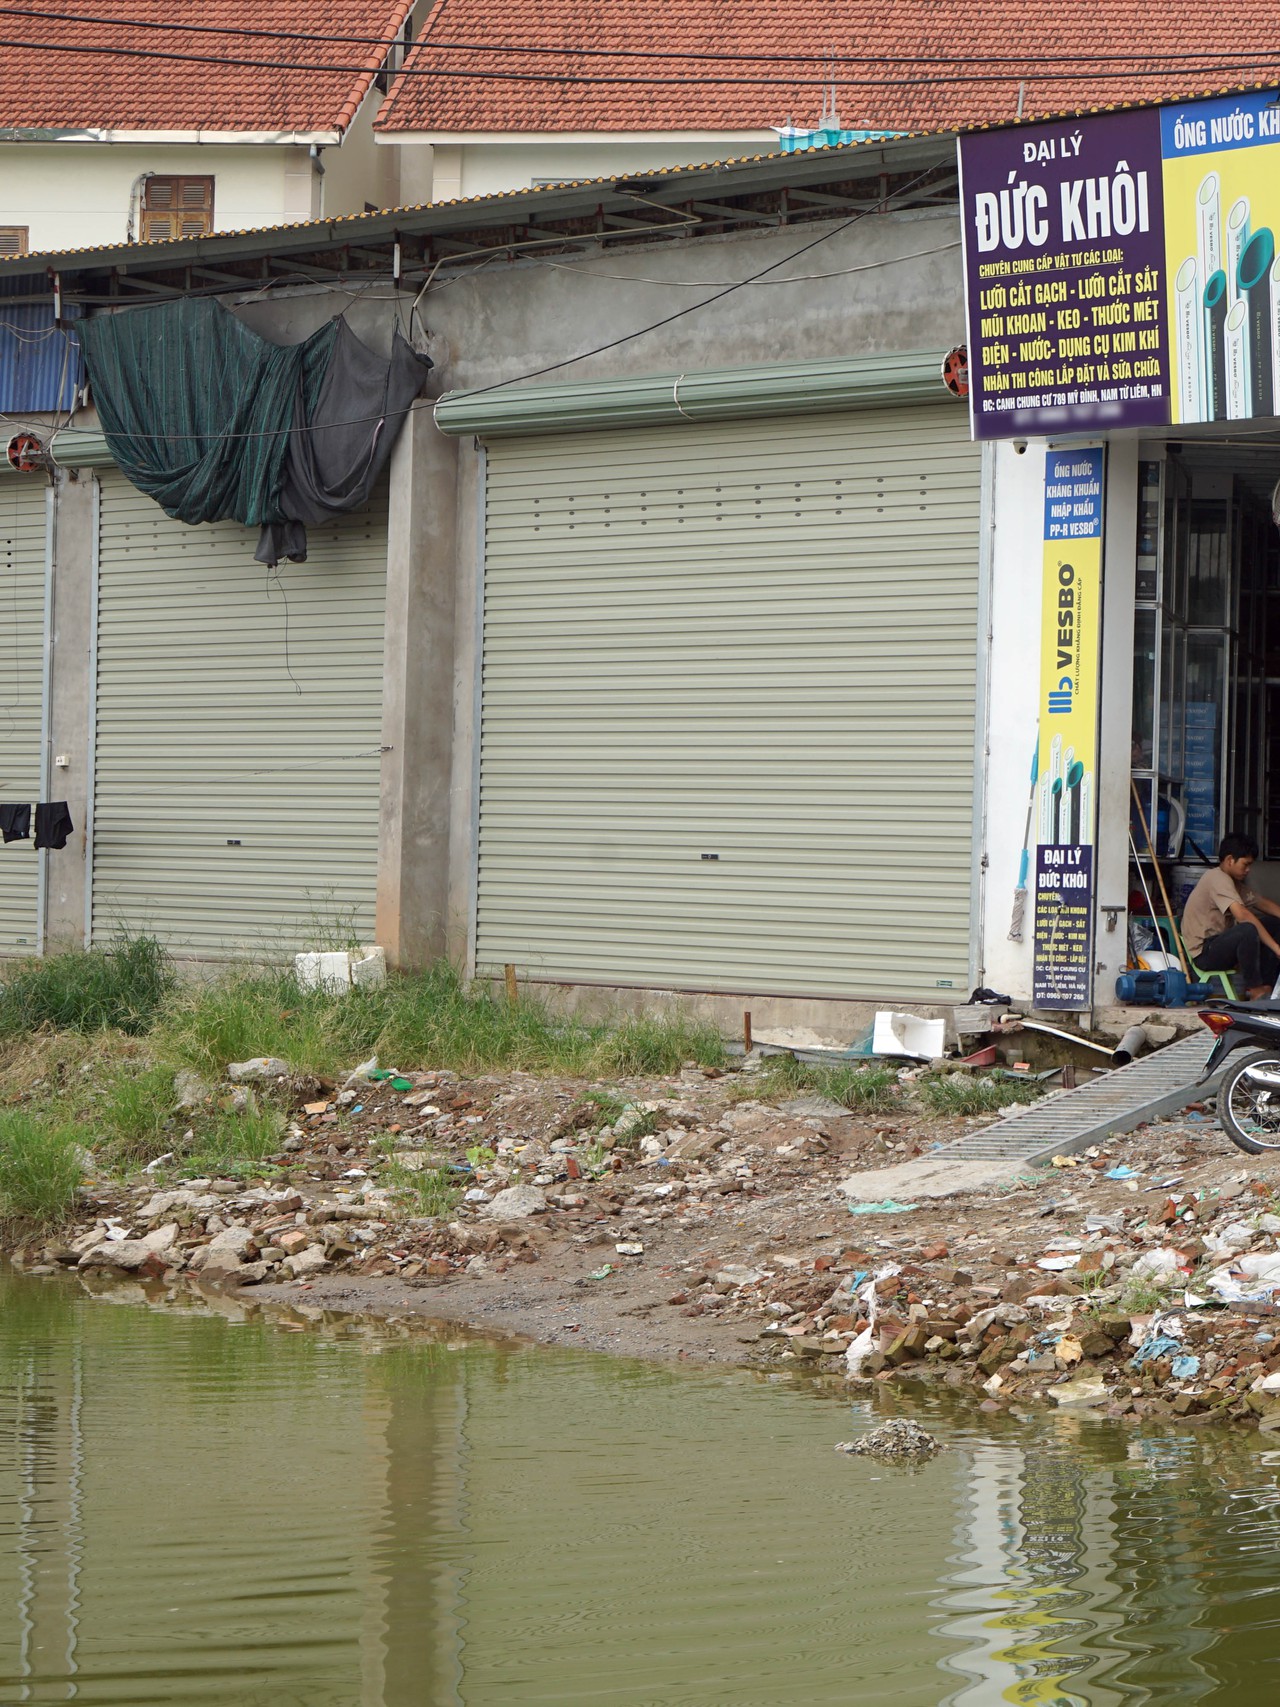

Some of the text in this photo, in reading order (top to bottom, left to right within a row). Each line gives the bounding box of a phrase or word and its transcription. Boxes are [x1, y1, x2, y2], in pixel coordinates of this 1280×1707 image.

[1174, 114, 1207, 149] ỐNG
[1210, 107, 1254, 144] NƯỚC
[1023, 129, 1084, 167] ĐẠI LÝ
[975, 159, 1150, 253] ĐỨC KHÔI
[979, 248, 1124, 278] CHUYÊN CUNG CẤP VẬT TƯ CÁC LOẠI:
[980, 283, 1007, 310] LƯỠI
[1009, 280, 1032, 307] CẮT
[1035, 281, 1067, 308] GẠCH
[1078, 272, 1106, 300] LƯỠI
[1108, 268, 1132, 296] CẮT
[1135, 265, 1159, 293] SẮT
[981, 313, 1004, 338] MŨI
[1006, 312, 1047, 336] KHOAN
[1057, 308, 1081, 330] KEO
[1091, 298, 1130, 327] THƯỚC
[1133, 296, 1159, 322] MÉT
[982, 342, 1010, 368] ĐIỆN
[1058, 336, 1091, 362] DỤNG
[1093, 334, 1110, 359] CỤ
[1112, 331, 1136, 353] KIM
[1138, 325, 1160, 351] KHÍ
[983, 356, 1161, 394] NHẬN THI CÔNG LẮP ĐẶT VÀ SỮA CHỮA
[983, 383, 1162, 412] ĐC: CẠNH CHUNG CƯ 789 MỸ ĐÌNH, NAM TỪ LIÊM, HN
[1054, 459, 1092, 478] ỐNG NƯỚC
[1046, 477, 1099, 498] KHÁNG KHUẨN
[1051, 497, 1094, 520] NHẬP KHẨU
[1050, 523, 1068, 537] PP-R
[1044, 846, 1082, 868] ĐẠI LÝ
[1038, 869, 1088, 889] ĐỨC KHÔI
